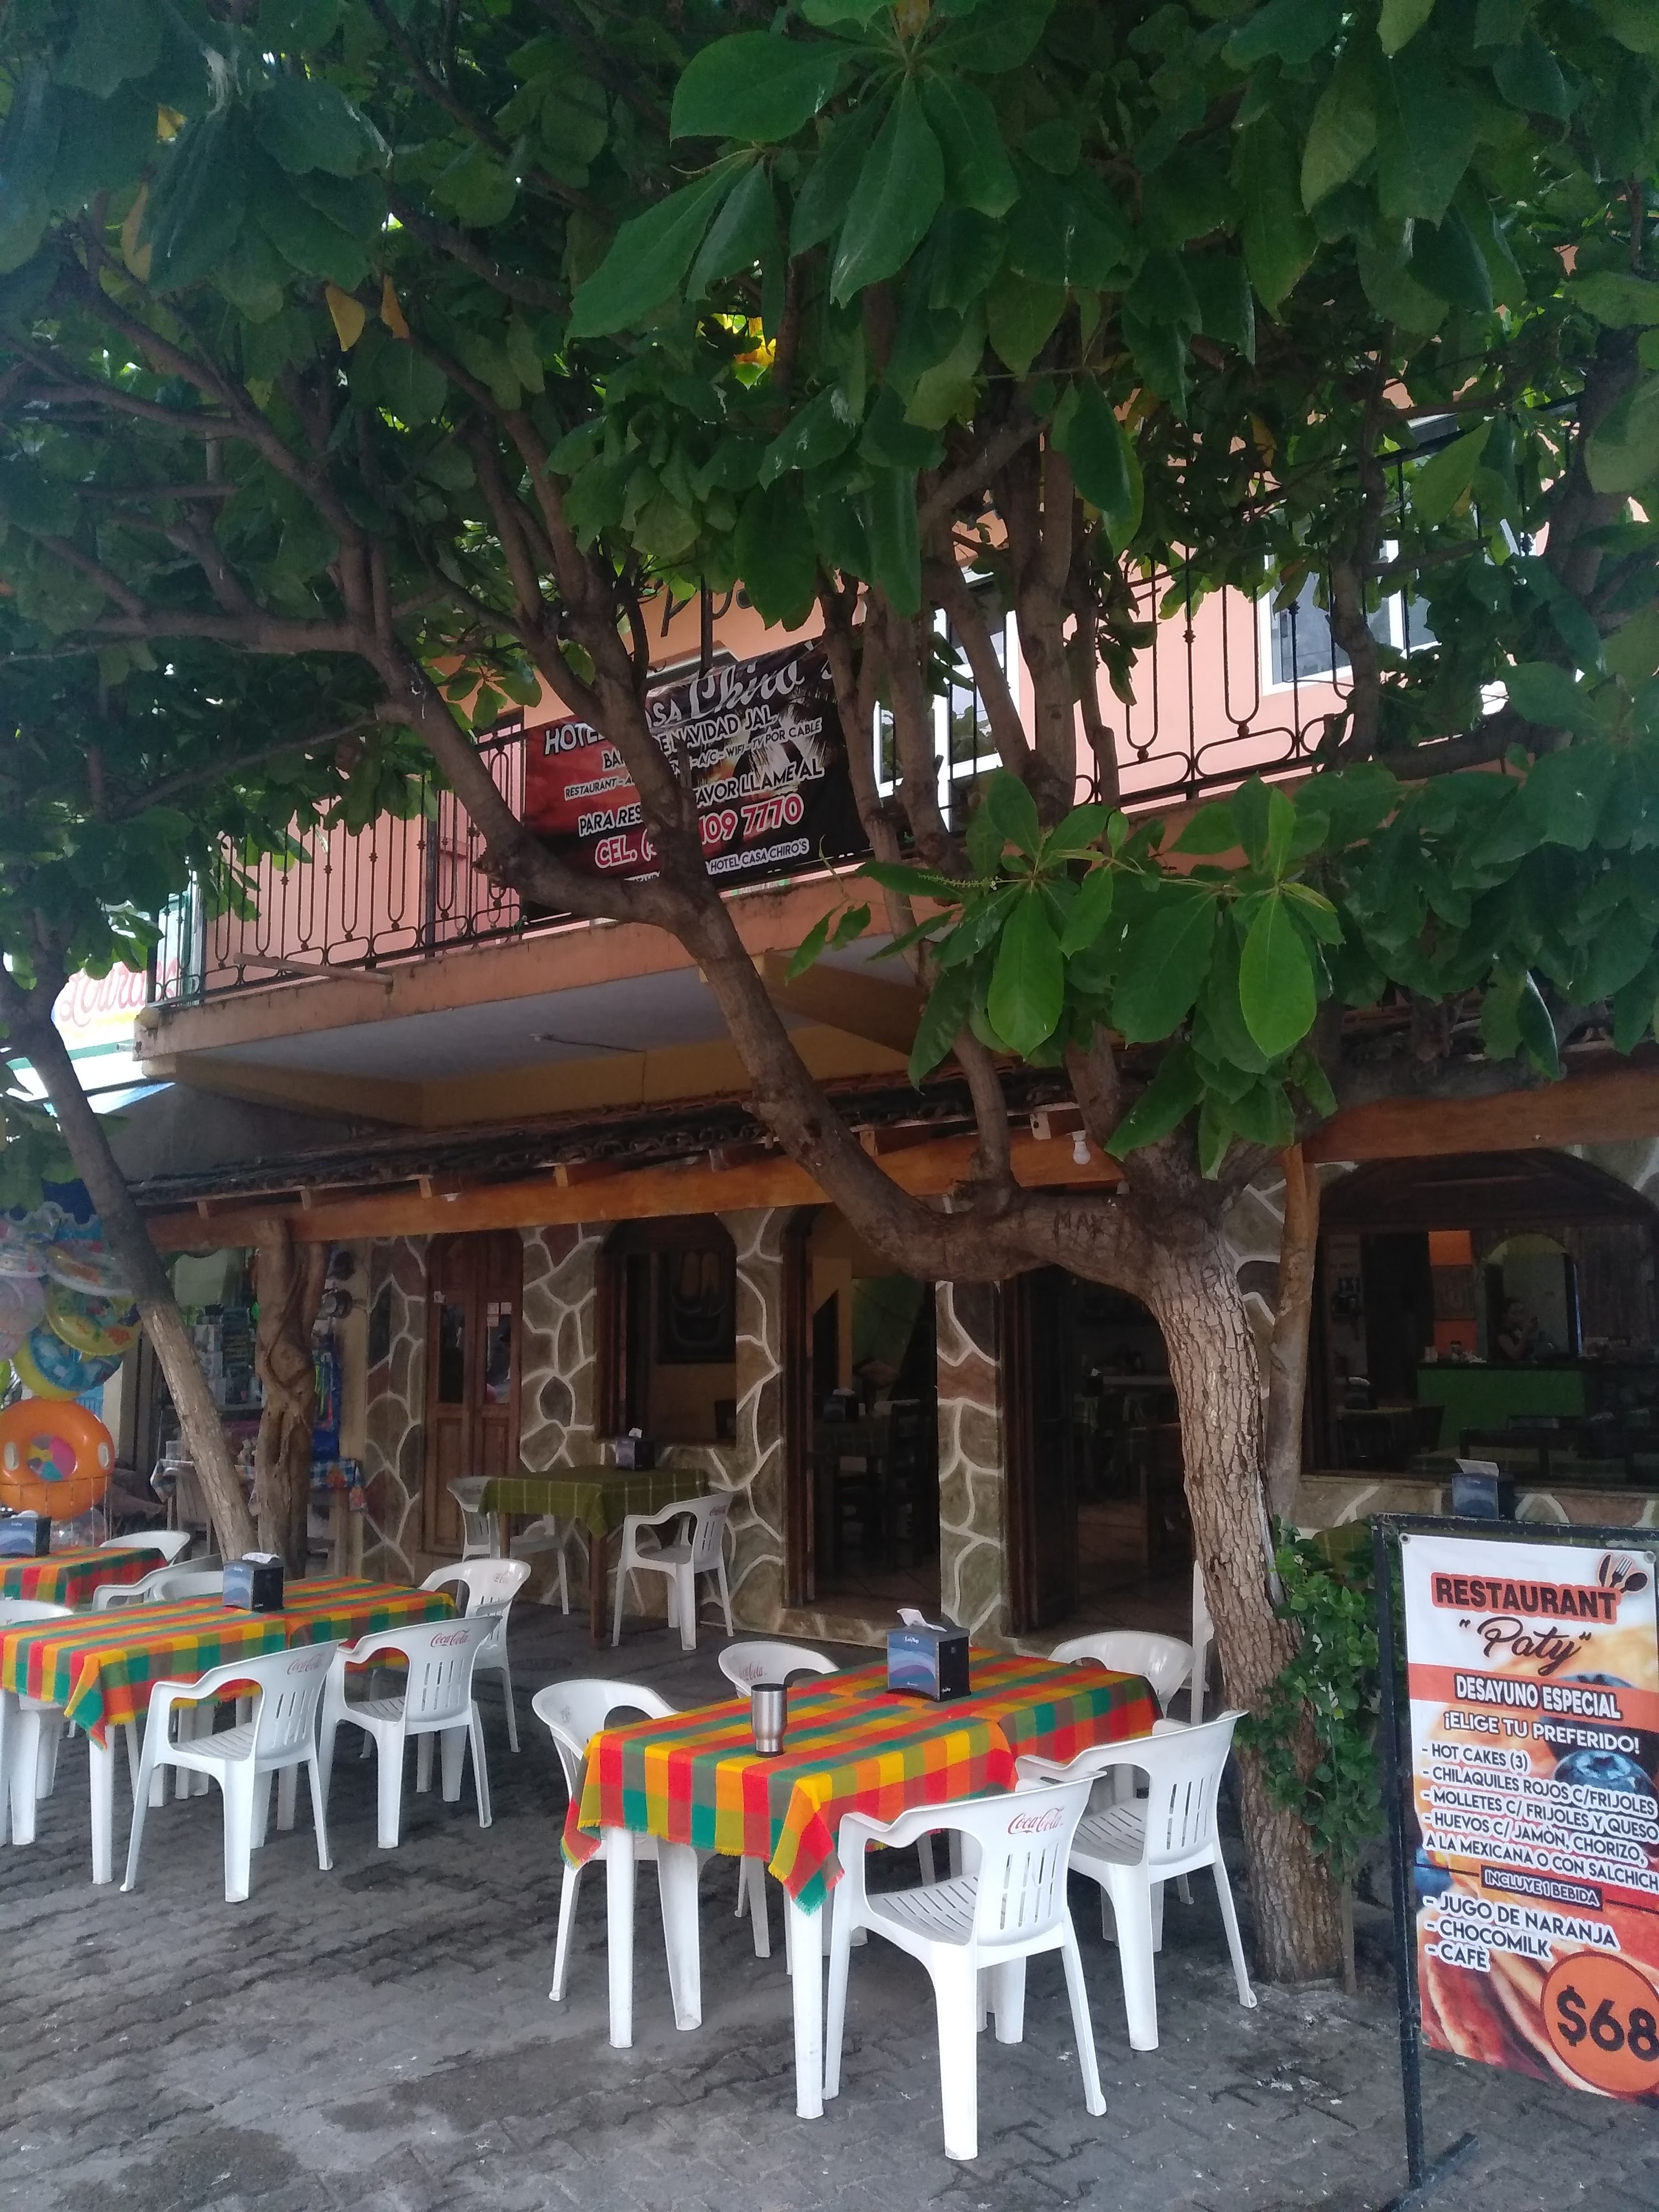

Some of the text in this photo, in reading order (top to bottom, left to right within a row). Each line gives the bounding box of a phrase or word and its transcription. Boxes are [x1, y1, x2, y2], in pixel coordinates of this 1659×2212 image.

[545, 723, 604, 755] HOTE
[765, 731, 785, 743] POR
[789, 720, 820, 738] CABLE
[565, 778, 617, 797] RESTAURANT
[695, 759, 823, 805] AVOR LLAME AL
[580, 805, 641, 831] PARA RES
[596, 836, 637, 867] CEL.
[742, 795, 802, 833] 7770
[711, 841, 807, 872] HOTEL CASA CHIRO'S
[1435, 1577, 1617, 1620] RESTAURANT
[1455, 1675, 1621, 1719] DESAYUNO ESPECIAL
[1504, 1721, 1528, 1736] TU
[1533, 1725, 1640, 1754] PREFERIDO!
[1432, 1743, 1459, 1760] HOT
[1463, 1747, 1506, 1766] CAKES
[1510, 1752, 1528, 1772] (3)
[1432, 1766, 1520, 1792] CHILAQUILES
[1523, 1779, 1569, 1800] ROJOS
[1433, 1789, 1503, 1812] MOLLETES
[1526, 1803, 1589, 1827] FRIJOLES
[1593, 1815, 1603, 1830] Y
[1608, 1818, 1658, 1840] QUESO
[1434, 1811, 1490, 1833] HUEVOS
[1573, 1835, 1645, 1865] CHORIZO,
[1426, 1833, 1659, 1892] A LA MEXICANA O CON SALCHICH
[1486, 1870, 1598, 1906] INCLUYE 1 BEBIDA
[1439, 1896, 1492, 1919] JUGO
[1498, 1912, 1520, 1926] DE
[1525, 1914, 1616, 1948] NARANJA
[1439, 1919, 1550, 1958] CHOCOMILK
[1556, 1984, 1659, 2062] $68
